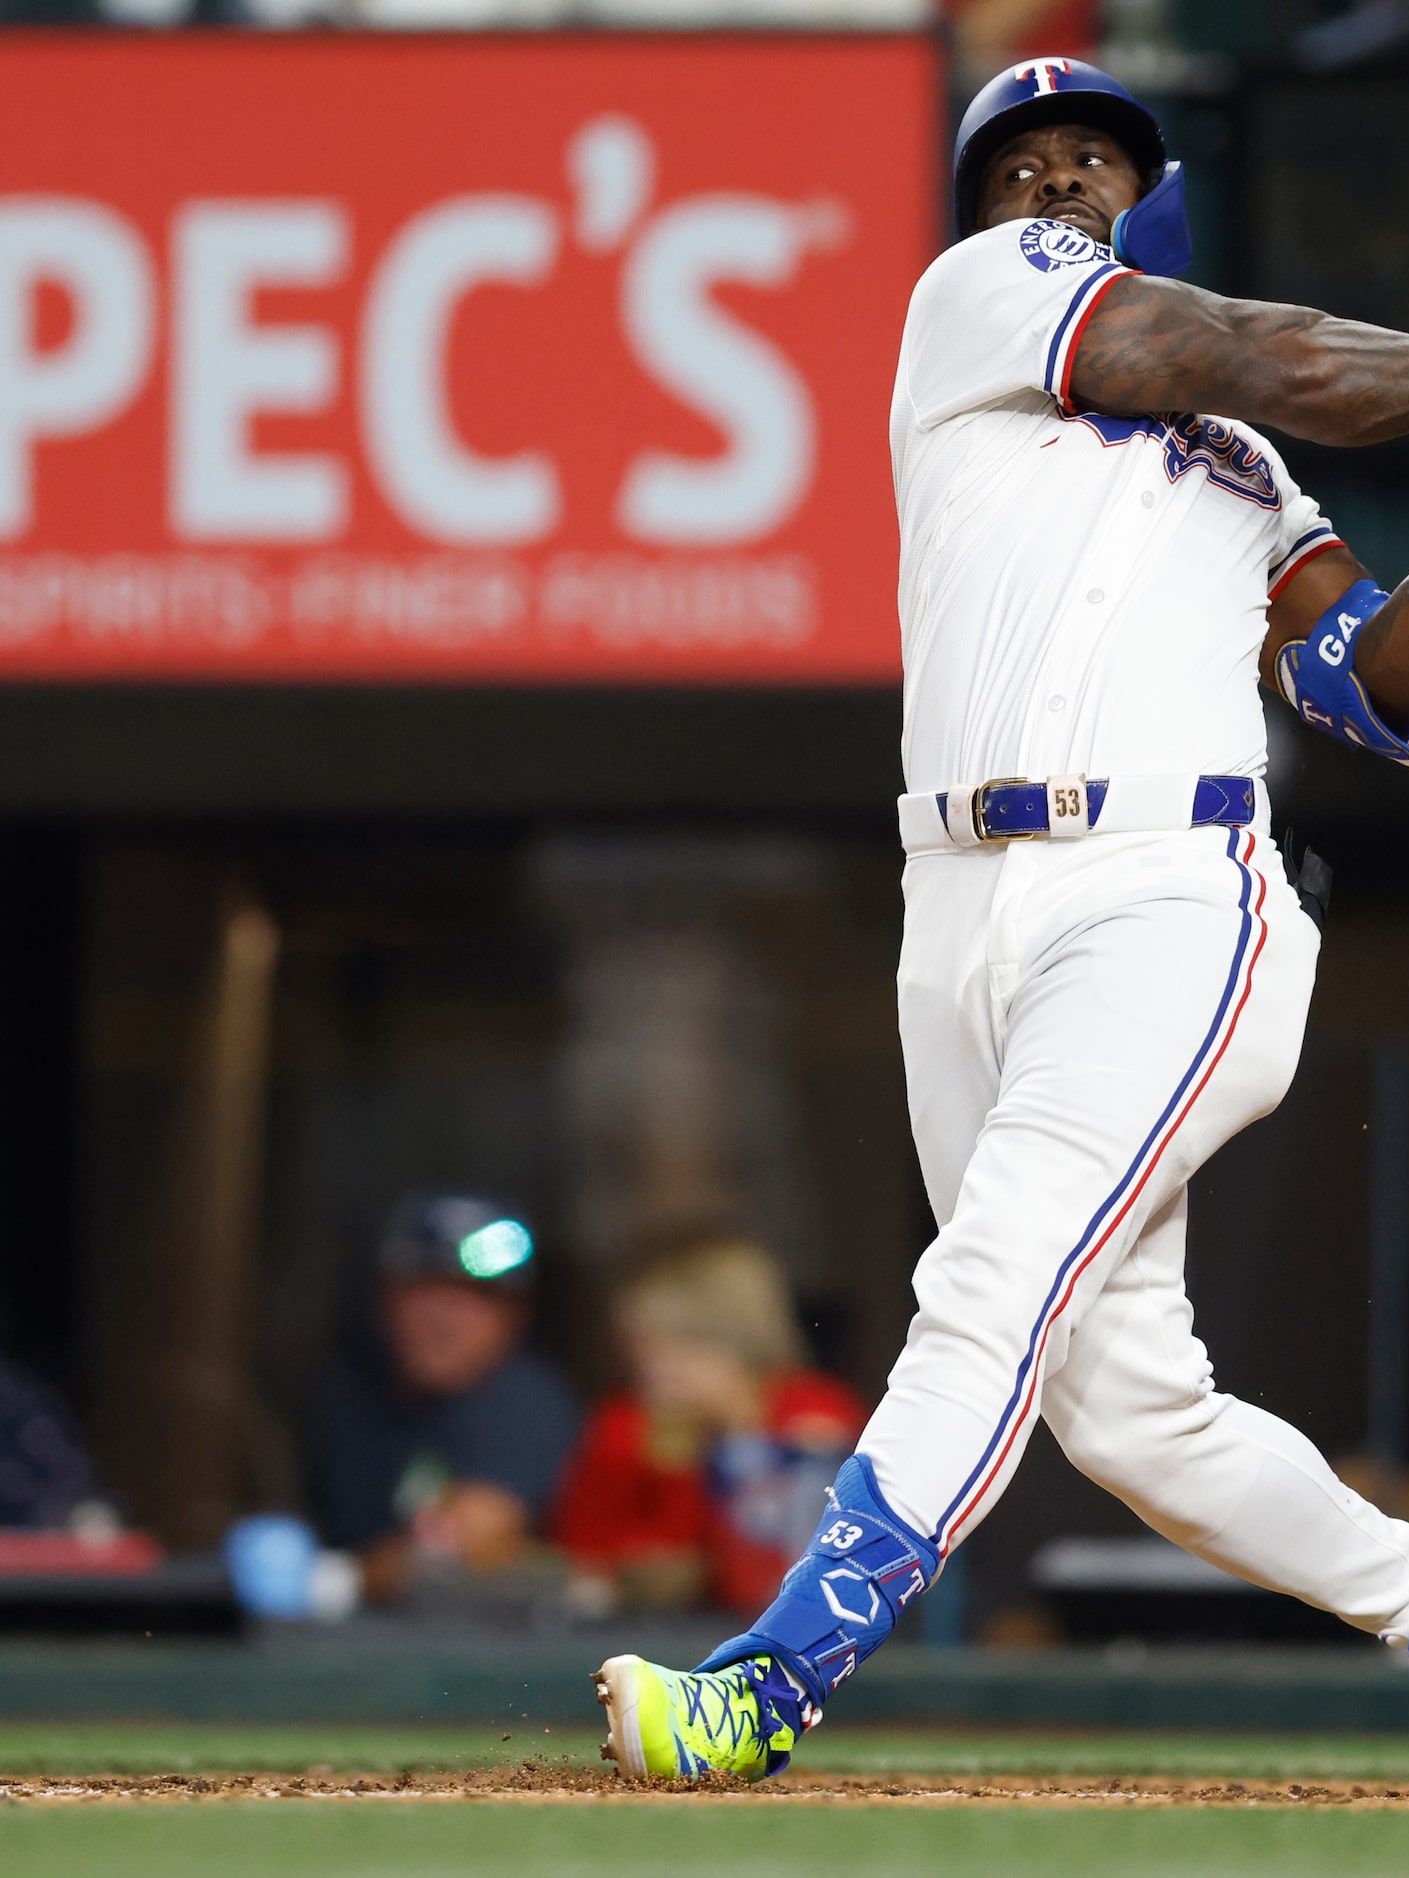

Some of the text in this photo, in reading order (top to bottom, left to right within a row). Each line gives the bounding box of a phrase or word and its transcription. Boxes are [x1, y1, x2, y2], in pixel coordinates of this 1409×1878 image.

[1014, 56, 1072, 97] T
[1055, 788, 1080, 817] 53
[820, 1520, 863, 1549] 53
